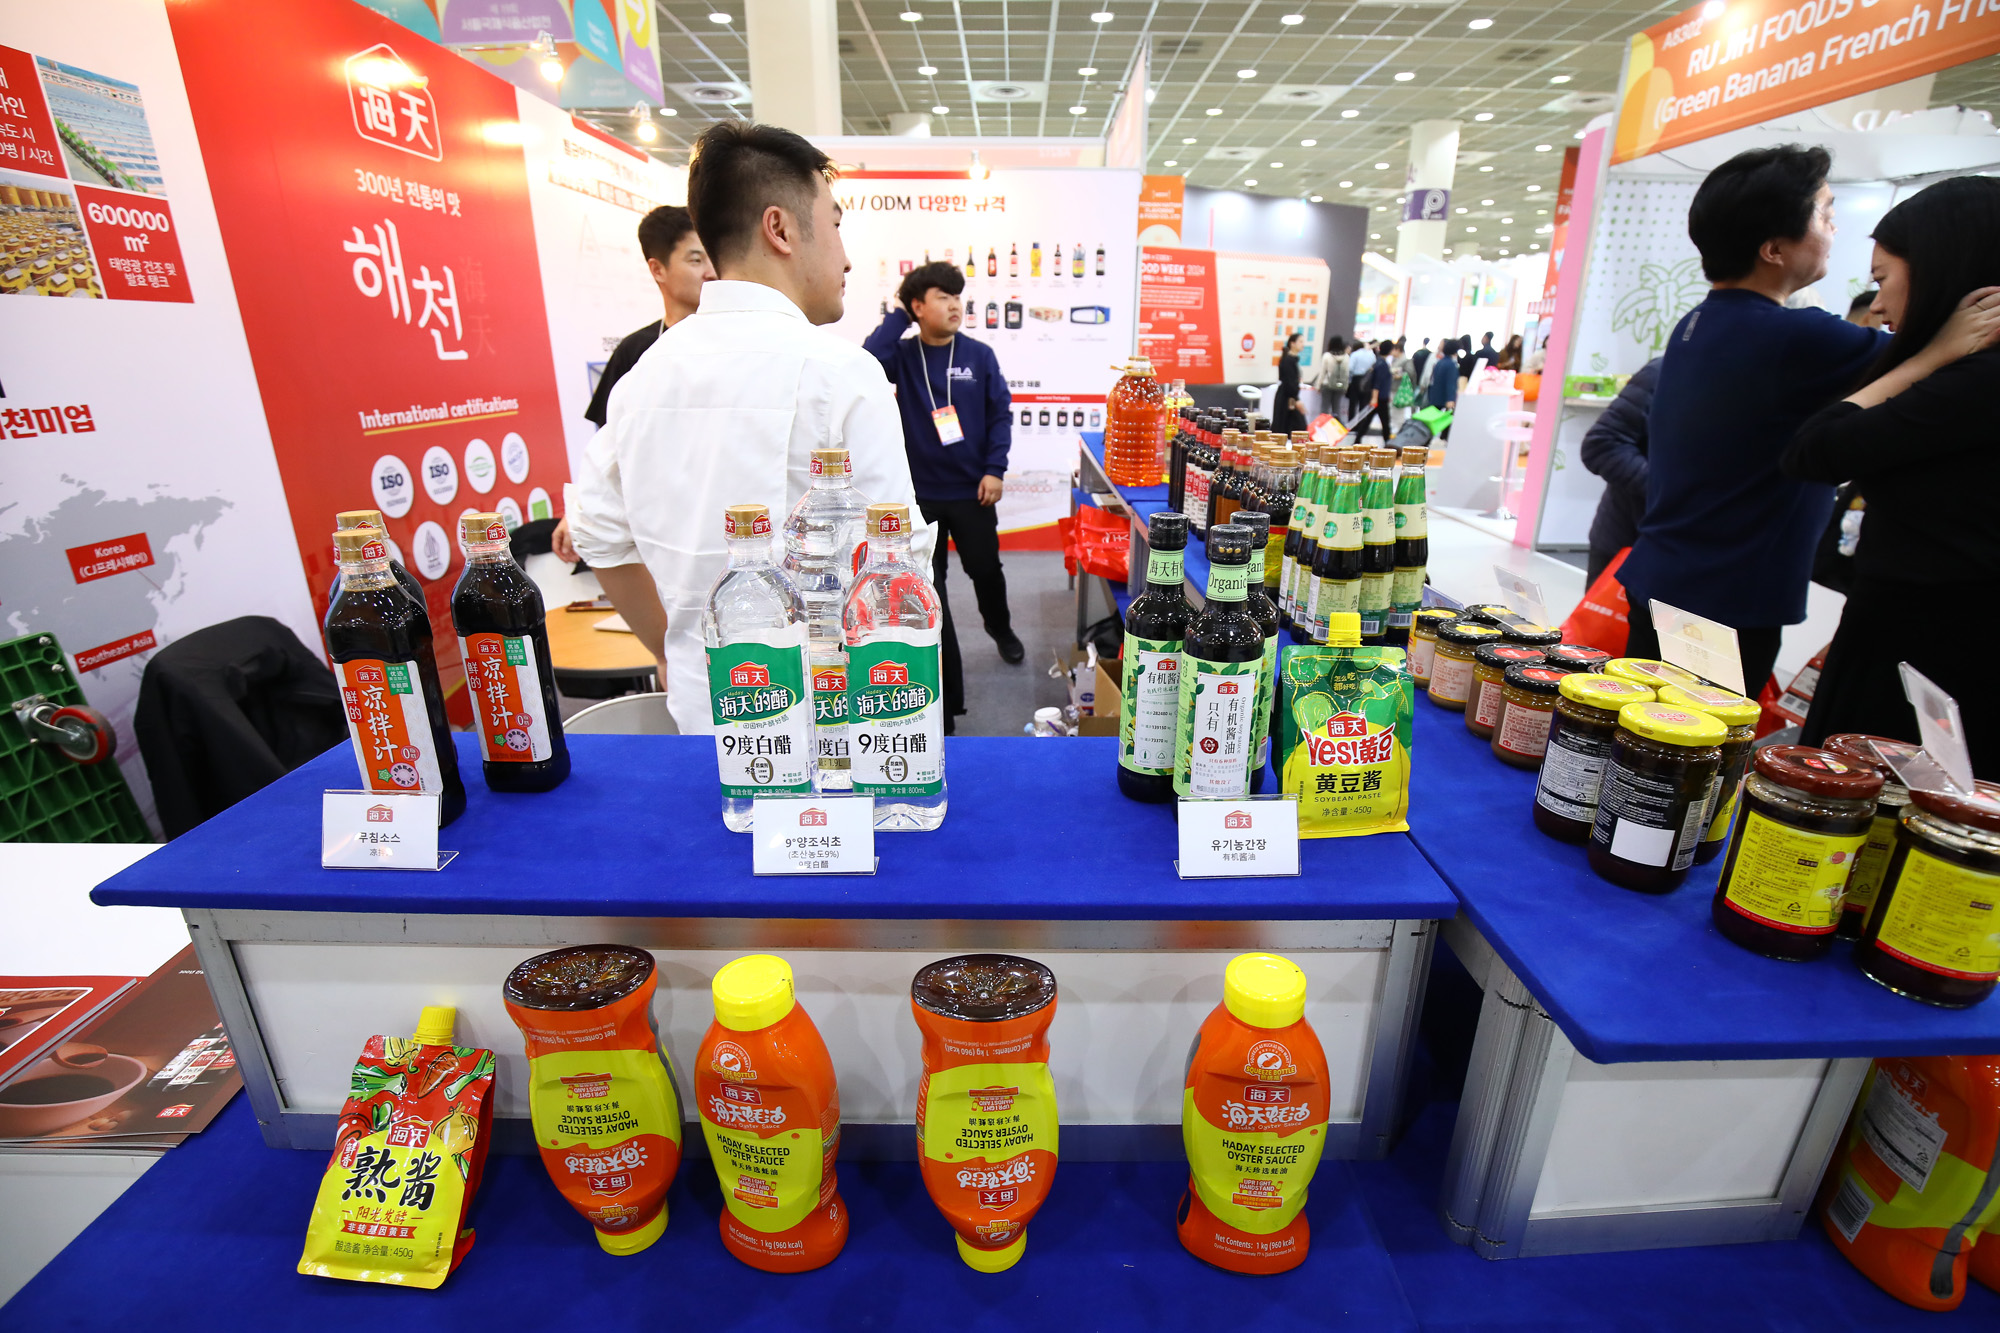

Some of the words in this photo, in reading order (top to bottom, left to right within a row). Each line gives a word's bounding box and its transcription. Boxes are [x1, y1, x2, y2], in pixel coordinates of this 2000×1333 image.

[1686, 46, 1720, 78] RU
[1759, 0, 1854, 50] FOODS
[1653, 84, 1720, 131] (Green
[1722, 51, 1816, 104] Banana
[1819, 4, 1931, 71] French
[360, 82, 432, 152] 海天
[22, 127, 36, 144] 시
[29, 147, 55, 166] 시간
[354, 168, 402, 205] 300년
[404, 181, 448, 215] 전통의
[446, 192, 462, 218] 맛
[870, 195, 912, 211] ODM
[917, 194, 968, 213] 다양한
[974, 195, 1006, 213] 규격
[88, 202, 170, 233] 600000
[108, 257, 142, 274] 태양광
[143, 260, 164, 275] 건조
[1160, 264, 1185, 276] WEEK
[342, 217, 470, 361] 해천
[946, 366, 973, 376] FILA
[359, 402, 450, 430] International
[450, 396, 519, 418] certifications
[0, 403, 96, 440] 천미업
[429, 463, 450, 479] ISO
[380, 473, 404, 490] ISO
[753, 520, 771, 532] 海天
[881, 519, 900, 531] 海天
[94, 542, 126, 559] Korea
[363, 545, 386, 558] 海天
[1208, 572, 1247, 593] Organic
[78, 641, 132, 669] Southeast
[132, 634, 155, 652] Asia
[480, 644, 499, 653] 海天
[1158, 662, 1176, 670] 海天
[359, 671, 381, 681] 海天
[467, 661, 482, 689] 鲜的
[733, 670, 766, 685] 海天
[873, 669, 904, 683] 海天
[1333, 671, 1356, 682] 怎么吃
[816, 677, 843, 690] 海天
[1219, 685, 1237, 694] 海天
[1333, 681, 1357, 692] 都好吃
[481, 656, 514, 730] 凉拌汁
[345, 690, 363, 720] 鲜的
[718, 687, 789, 719] 海天的醋
[856, 687, 926, 717] 海天的醋
[361, 684, 399, 764] 凉拌汁
[1206, 701, 1220, 733] 只有
[1224, 697, 1240, 756] 有机酱油
[1330, 720, 1363, 736] 海天
[722, 734, 792, 756] 9度白醋
[858, 733, 927, 755] 9度白醋
[1301, 722, 1396, 767] Yes!黄豆
[1315, 769, 1383, 795] 黄豆酱
[1314, 795, 1354, 803] SOYBEAN
[1357, 792, 1382, 800] PASTE
[369, 810, 391, 821] 海天
[802, 813, 825, 825] 海天
[1227, 816, 1250, 827] 海天
[785, 835, 842, 848] 9°양조식초
[1211, 838, 1267, 851] 유기농간장
[369, 848, 393, 857] 凉拌
[1222, 852, 1256, 862] 有机酱油
[733, 1071, 755, 1079] BOTTLE
[1246, 1065, 1272, 1076] SQUEEZE
[1273, 1066, 1295, 1076] BOTTLE
[724, 1086, 755, 1103] 海天
[1250, 1088, 1285, 1102] 海天
[160, 1107, 190, 1118] 海天
[594, 1110, 631, 1122] OYSTER
[708, 1094, 787, 1124] 海天蚝油
[1221, 1099, 1311, 1129] 海天蚝油
[561, 1114, 593, 1125] SAUCE
[605, 1119, 639, 1135] HADAY
[968, 1114, 1021, 1127] 海天珍选蚝油
[392, 1126, 427, 1146] 海天
[557, 1124, 603, 1136] SELECTED
[961, 1128, 993, 1139] SAUCE
[995, 1124, 1029, 1137] OYSTER
[716, 1132, 742, 1150] HADAY
[744, 1144, 790, 1156] SELECTED
[955, 1138, 1002, 1150] SELECTED
[1003, 1133, 1034, 1148] HADAY
[1222, 1138, 1257, 1153] HADAY
[1258, 1144, 1305, 1155] SELECTED
[565, 1140, 649, 1175] 海天蚝油
[722, 1145, 752, 1163] OYSTER
[753, 1155, 785, 1166] SAUCE
[1227, 1150, 1263, 1164] OYSTER
[1265, 1155, 1298, 1165] SAUCE
[342, 1145, 442, 1212] 熟酱
[956, 1155, 1036, 1190] 海天蚝油
[593, 1175, 627, 1189] 海天
[1243, 1179, 1272, 1187] UPRIGHT
[984, 1190, 1015, 1203] 海天
[355, 1205, 408, 1225] 阳光发酵
[347, 1222, 409, 1237] 非转基因黄豆
[735, 1229, 759, 1245] Contents:
[764, 1240, 773, 1249] kg
[773, 1240, 787, 1250] (960
[787, 1239, 804, 1249] kcal)
[1215, 1233, 1226, 1243] Net
[1225, 1236, 1253, 1249] Contents:
[1260, 1241, 1269, 1251] kg
[1269, 1240, 1282, 1251] (960
[1282, 1236, 1295, 1247] kcal)
